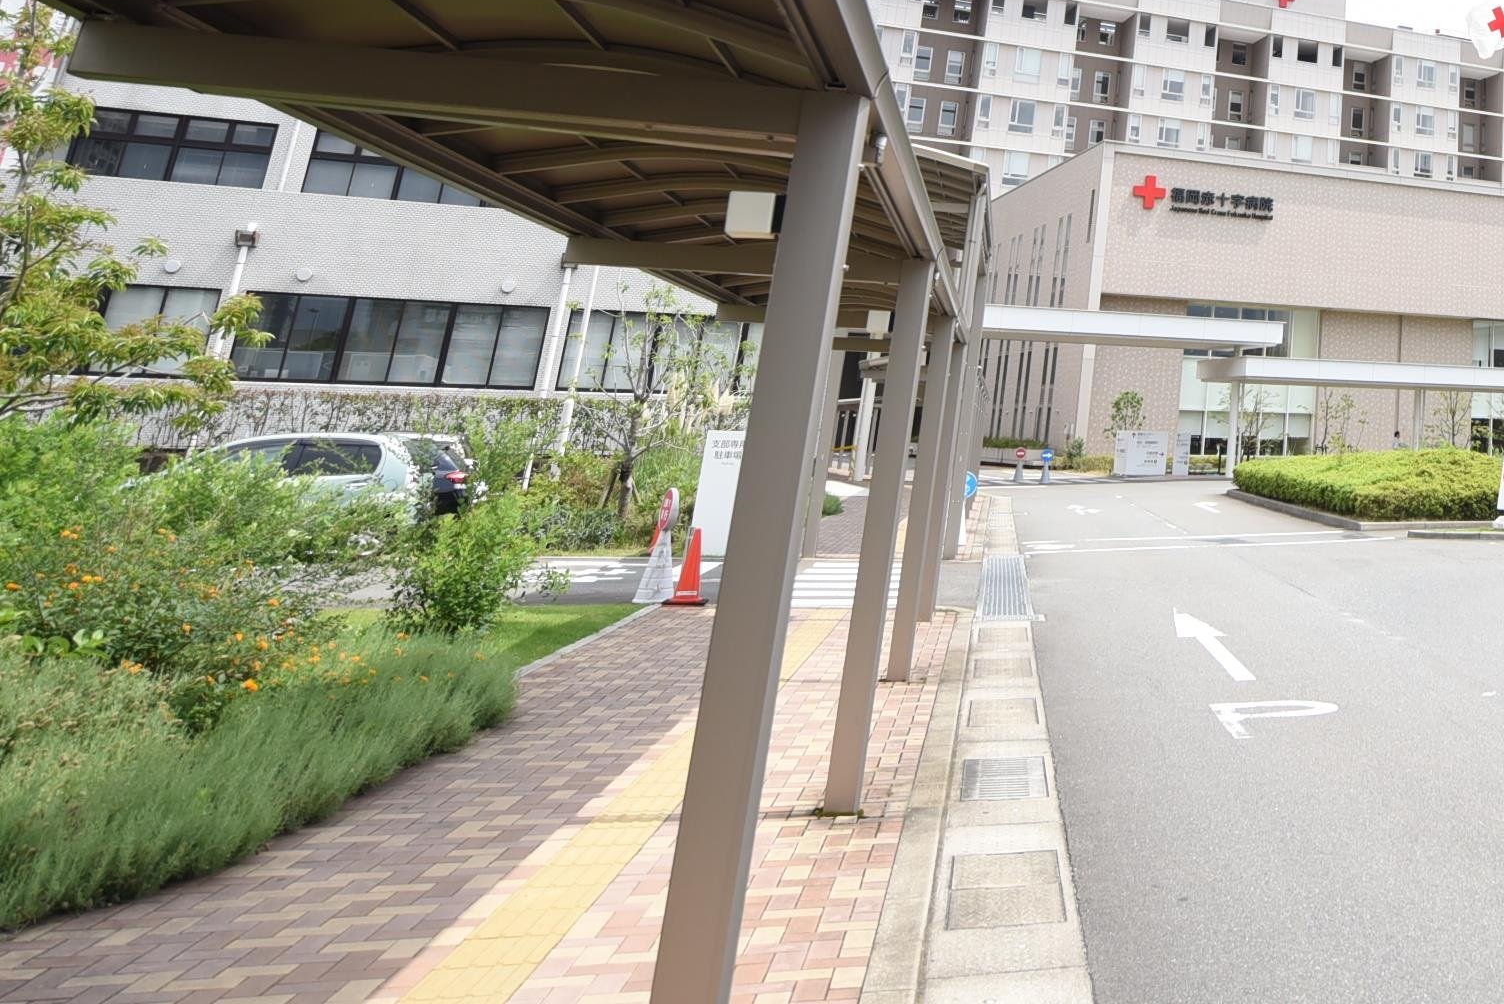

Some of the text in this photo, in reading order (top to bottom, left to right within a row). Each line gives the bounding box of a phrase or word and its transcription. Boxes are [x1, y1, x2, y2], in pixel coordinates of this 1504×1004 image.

[1170, 187, 1274, 213] 福岡赤十字病院
